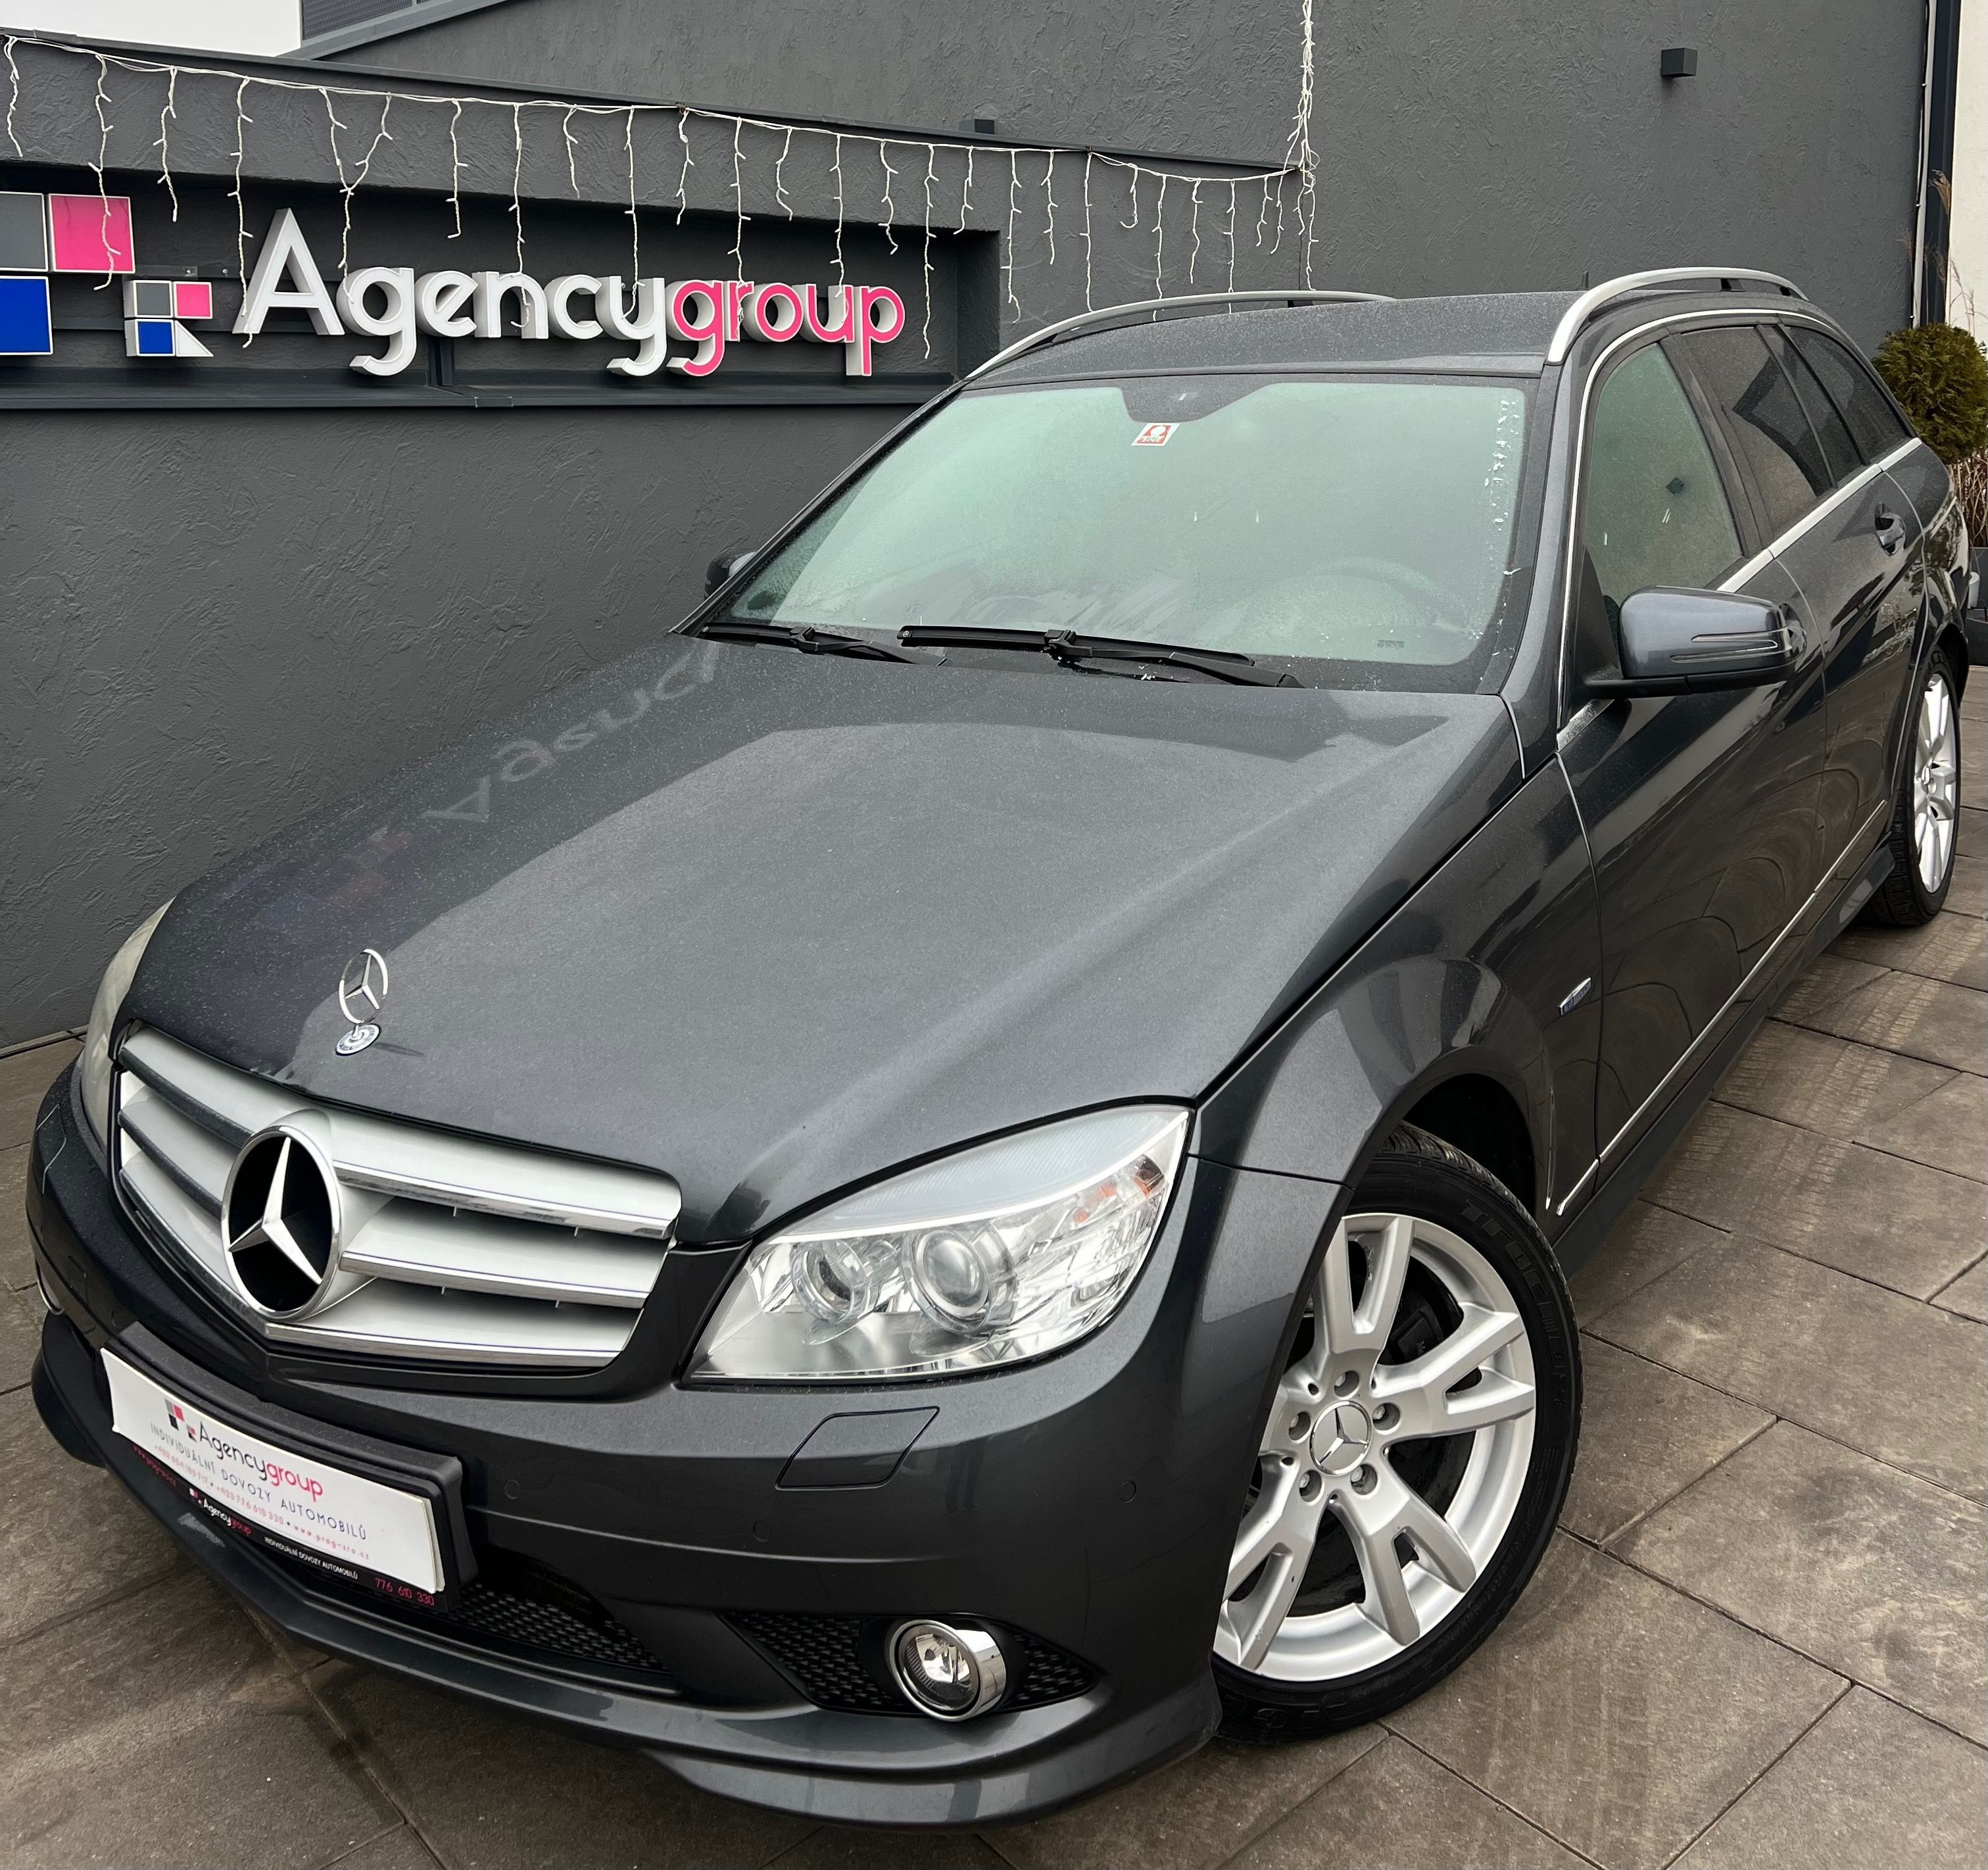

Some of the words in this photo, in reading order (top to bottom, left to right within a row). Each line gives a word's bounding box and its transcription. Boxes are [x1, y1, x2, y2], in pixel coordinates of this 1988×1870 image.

[231, 207, 906, 377] Agencygroup
[200, 1420, 324, 1503] Agencygroup
[222, 1469, 271, 1502] DOVOZY
[281, 1498, 366, 1540] AUTOMOBILŮ
[237, 1495, 251, 1510] 776
[374, 1577, 394, 1593] 776
[397, 1585, 412, 1600] 610
[417, 1594, 435, 1607] 330
